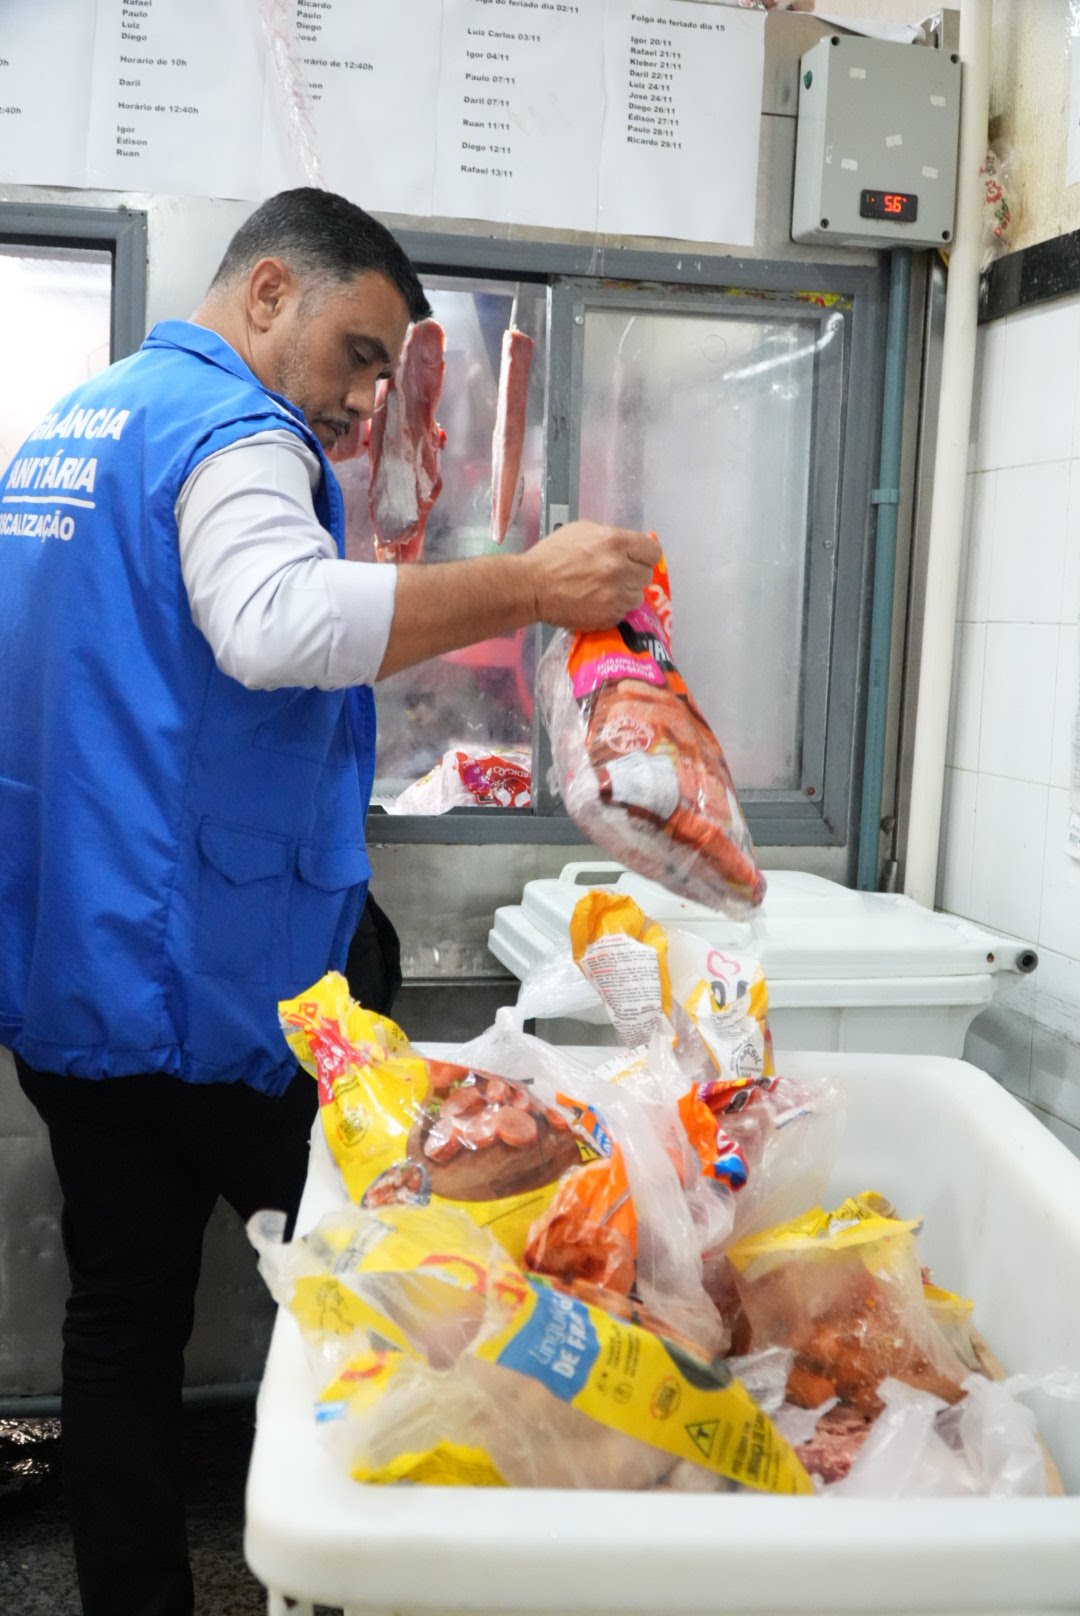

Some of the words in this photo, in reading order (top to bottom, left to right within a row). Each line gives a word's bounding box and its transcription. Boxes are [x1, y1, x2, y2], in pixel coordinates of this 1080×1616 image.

[297, 0, 332, 9] Ricardo
[541, 3, 554, 11] dia
[556, 4, 579, 14] 02/11
[122, 9, 148, 18] Paulo
[296, 10, 322, 20] Paulo
[121, 21, 141, 29] Luiz
[296, 21, 322, 32] Diego
[631, 14, 655, 25] Folga
[657, 17, 667, 25] do
[669, 19, 698, 29] feriado
[700, 22, 712, 30] dia
[121, 32, 147, 42] Diego
[467, 27, 485, 36] Luiz
[488, 30, 515, 40] Carlos
[518, 33, 541, 42] 03/11
[631, 36, 647, 45] Igor
[649, 38, 672, 47] 20/11
[466, 50, 484, 59] Igor
[486, 52, 509, 61] 04/11
[630, 47, 657, 57] Rafael
[660, 50, 681, 59] 21/11
[120, 56, 154, 66] Horário
[156, 58, 168, 66] de
[171, 59, 187, 67] 10h
[330, 60, 341, 68] de
[345, 61, 374, 71] 12:40h
[630, 58, 657, 68] Kleber
[660, 61, 682, 70] 21/11
[465, 73, 490, 82] Paulo
[492, 75, 515, 85] 07/11
[629, 69, 648, 79] Daril
[651, 72, 673, 80] 22/11
[119, 79, 140, 88] Daril
[629, 81, 645, 89] Luiz
[648, 83, 670, 91] 24/11
[464, 96, 484, 105] Daril
[487, 98, 510, 107] 07/11
[650, 94, 672, 103] 24/11
[118, 102, 152, 112] Horário
[154, 104, 165, 113] de
[169, 106, 199, 115] 12:40h
[628, 102, 652, 113] Diego
[653, 106, 676, 115] 26/11
[462, 118, 485, 128] Ruan
[487, 121, 510, 131] 11/11
[628, 114, 655, 124] Edison
[657, 117, 679, 126] 27/11
[117, 125, 135, 135] Igor
[627, 125, 650, 135] Paulo
[653, 128, 674, 137] 28/11
[116, 137, 148, 146] Edison
[627, 136, 659, 147] Ricardo
[660, 140, 682, 150] 29/11
[462, 141, 486, 151] Diego
[489, 145, 511, 154] 12/11
[116, 149, 140, 158] Ruan
[460, 164, 488, 175] Rafael
[491, 168, 513, 178] 13/11
